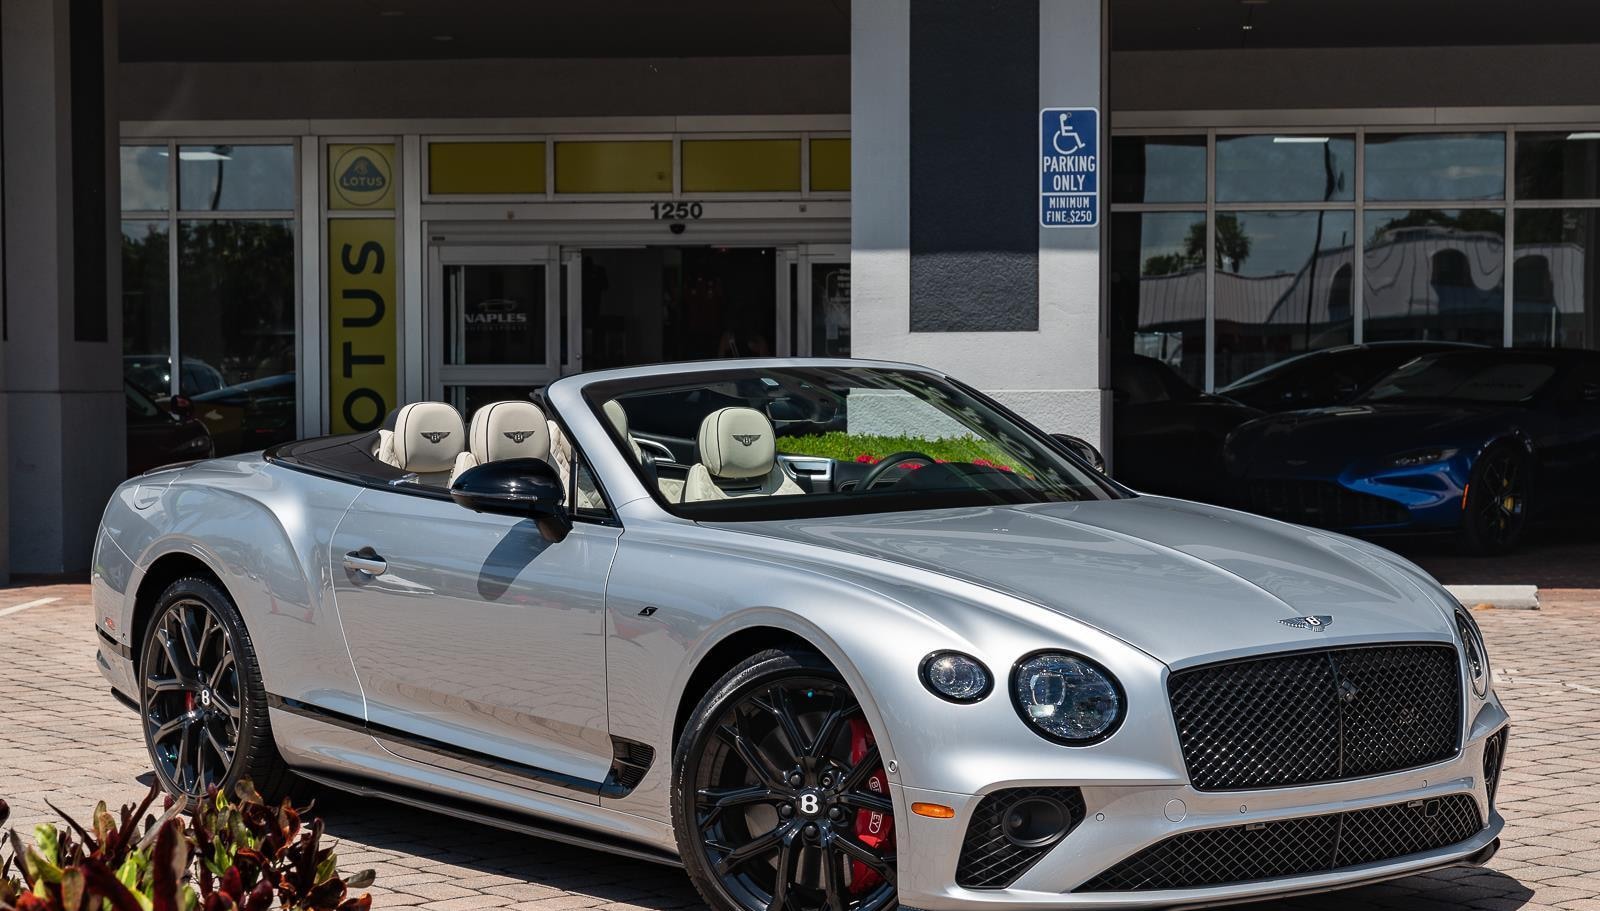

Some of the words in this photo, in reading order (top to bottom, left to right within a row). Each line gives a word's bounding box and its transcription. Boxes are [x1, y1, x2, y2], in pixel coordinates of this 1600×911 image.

[1043, 155, 1096, 173] PARKING
[342, 176, 384, 187] LOTUS
[1053, 174, 1086, 191] ONLY
[650, 202, 703, 220] 1250
[1049, 196, 1090, 209] MINIMUM
[1046, 210, 1068, 222] FINE
[1070, 210, 1092, 222] $250
[464, 312, 527, 323] NAPLES
[342, 240, 386, 432] OTUS
[801, 794, 819, 814] B
